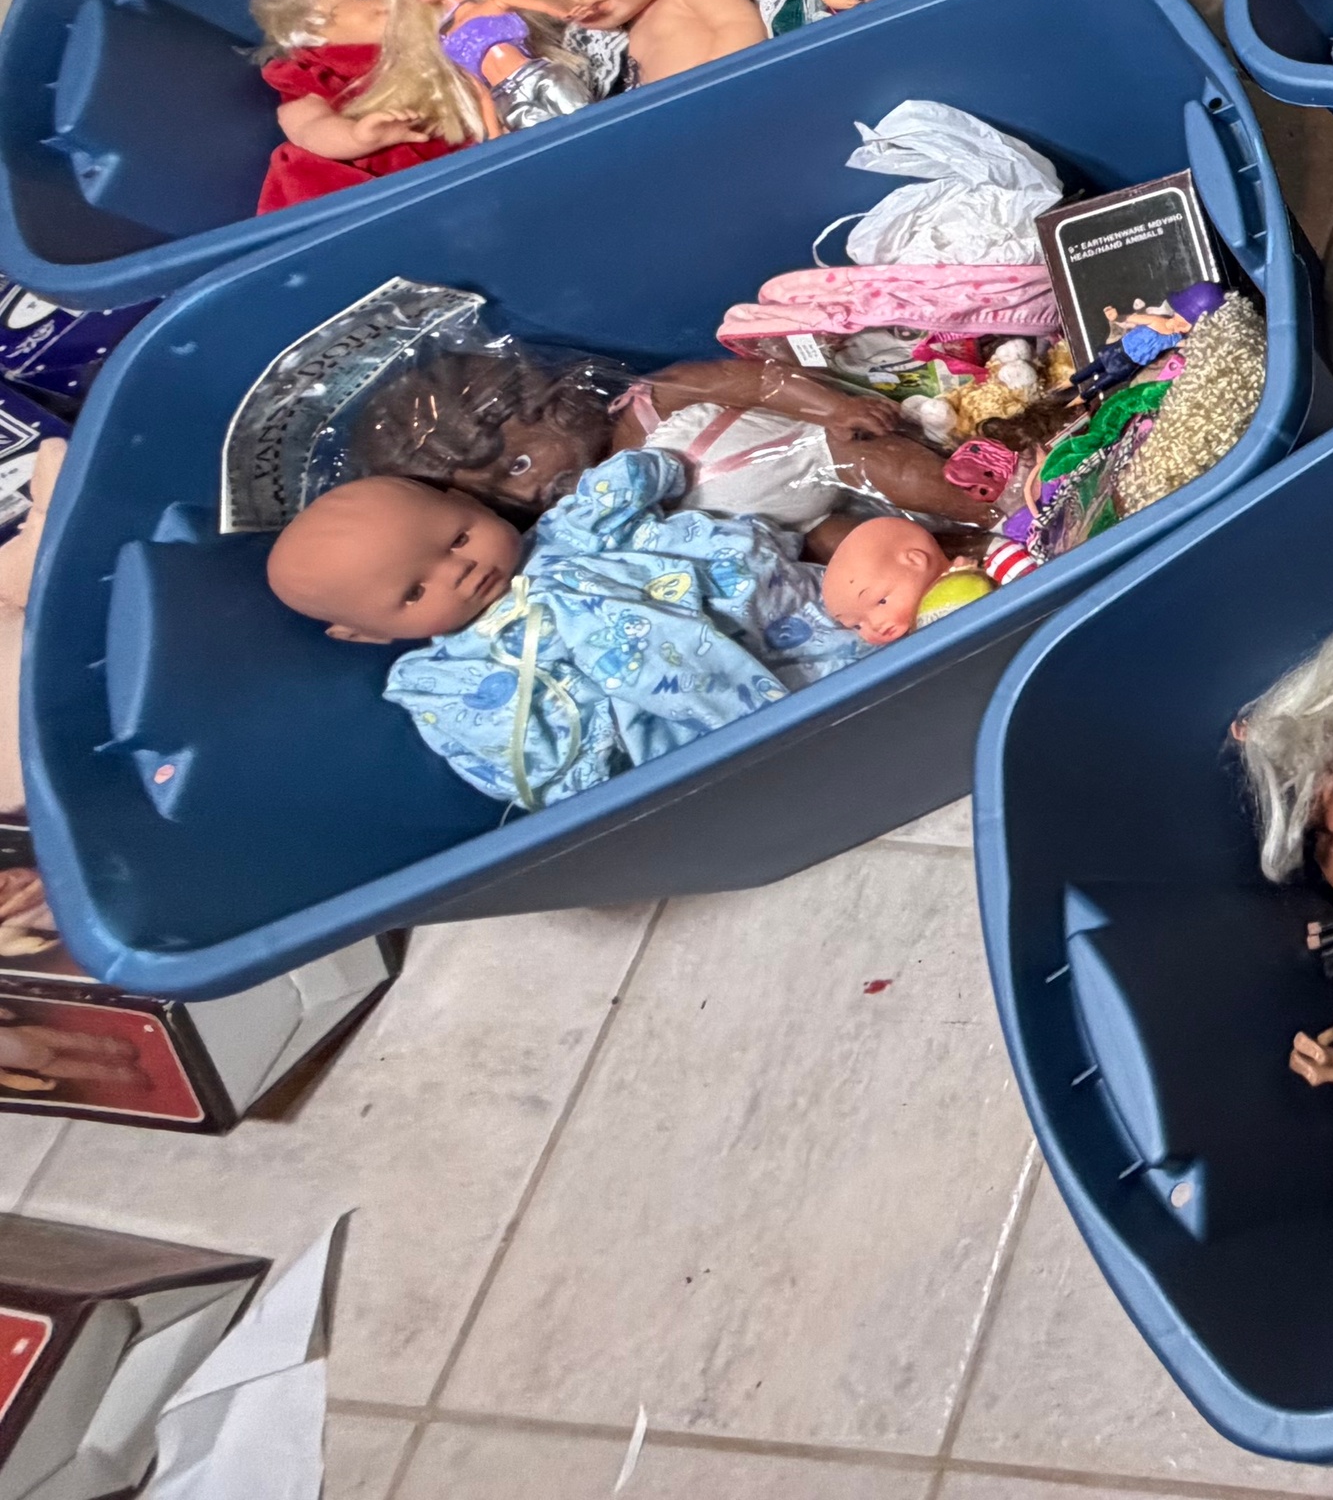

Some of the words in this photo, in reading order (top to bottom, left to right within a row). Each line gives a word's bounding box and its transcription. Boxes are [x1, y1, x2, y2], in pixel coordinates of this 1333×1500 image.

[1070, 240, 1123, 263] HEAD/HAND
[1125, 227, 1164, 246] ANIMALS
[1081, 223, 1146, 250] EARTHENWARE
[1147, 213, 1183, 229] MOVING
